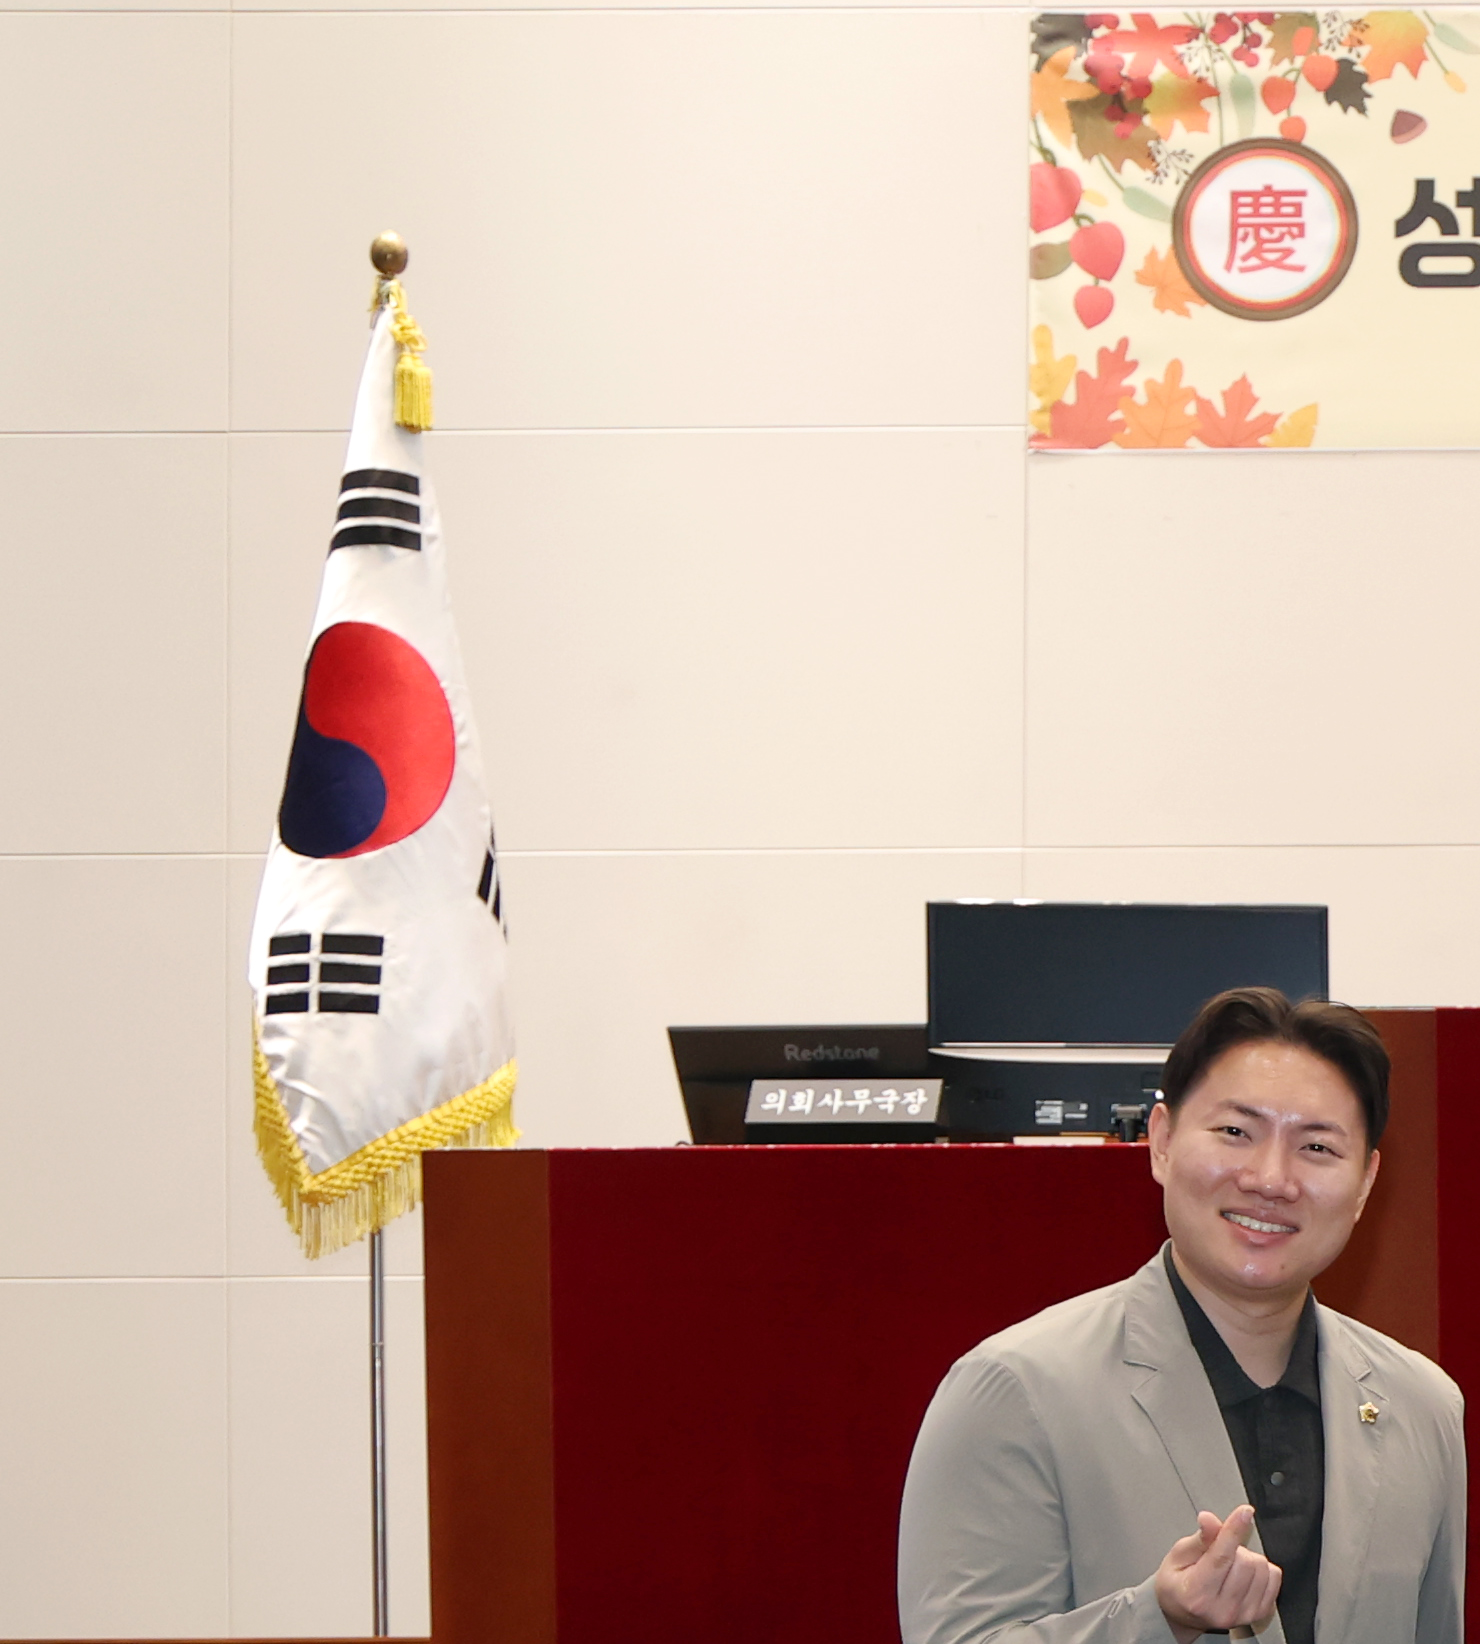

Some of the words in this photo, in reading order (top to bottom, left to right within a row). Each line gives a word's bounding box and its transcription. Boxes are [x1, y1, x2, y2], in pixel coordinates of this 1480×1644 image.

[1225, 184, 1307, 275] 慶
[783, 1043, 880, 1062] Redstone
[760, 1088, 928, 1116] 의회사무국장
